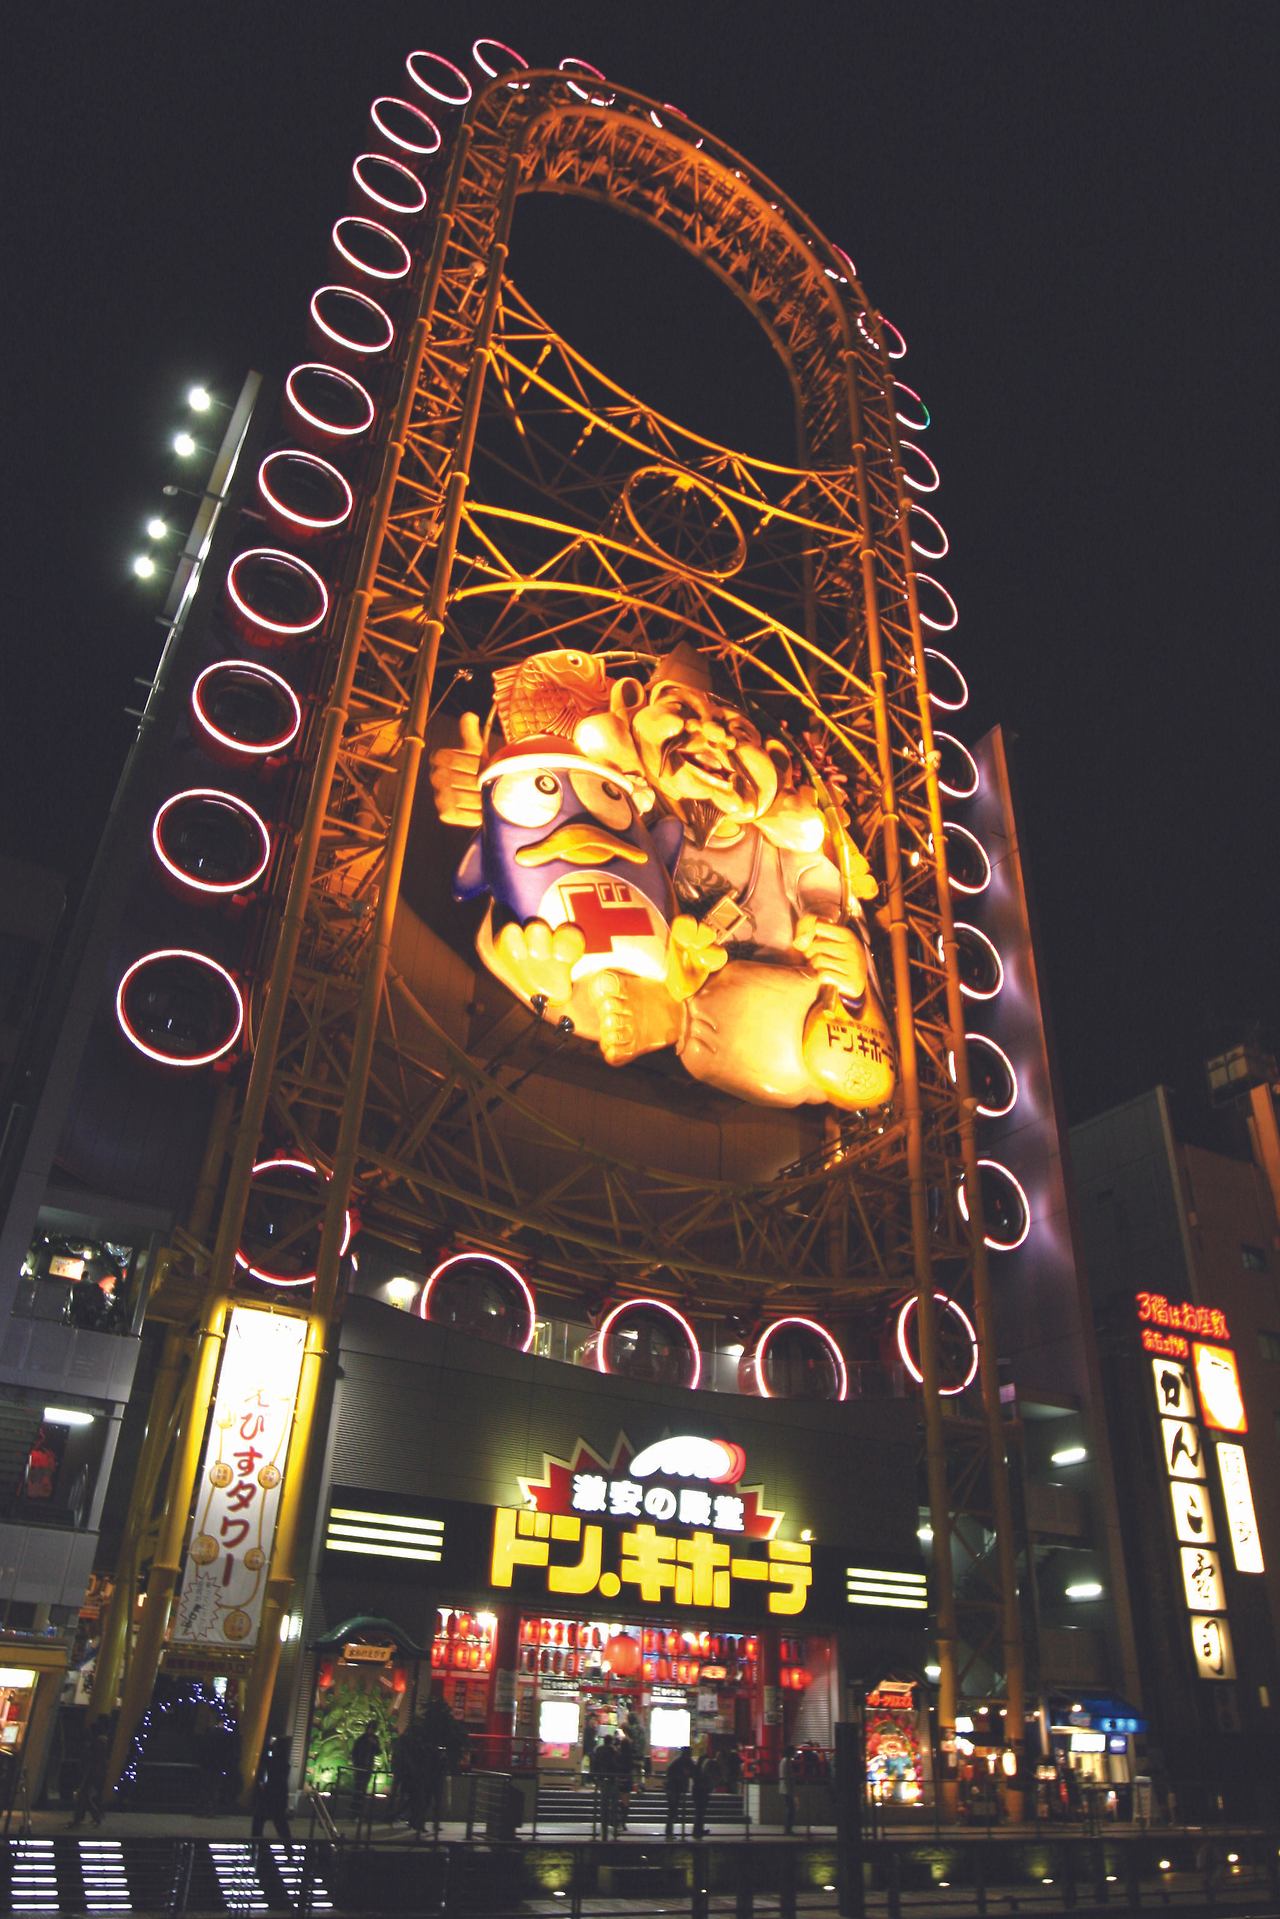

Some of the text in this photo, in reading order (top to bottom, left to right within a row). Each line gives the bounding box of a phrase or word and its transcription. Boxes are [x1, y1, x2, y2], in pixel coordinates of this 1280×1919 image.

[573, 1474, 745, 1531] 激安の殿堂
